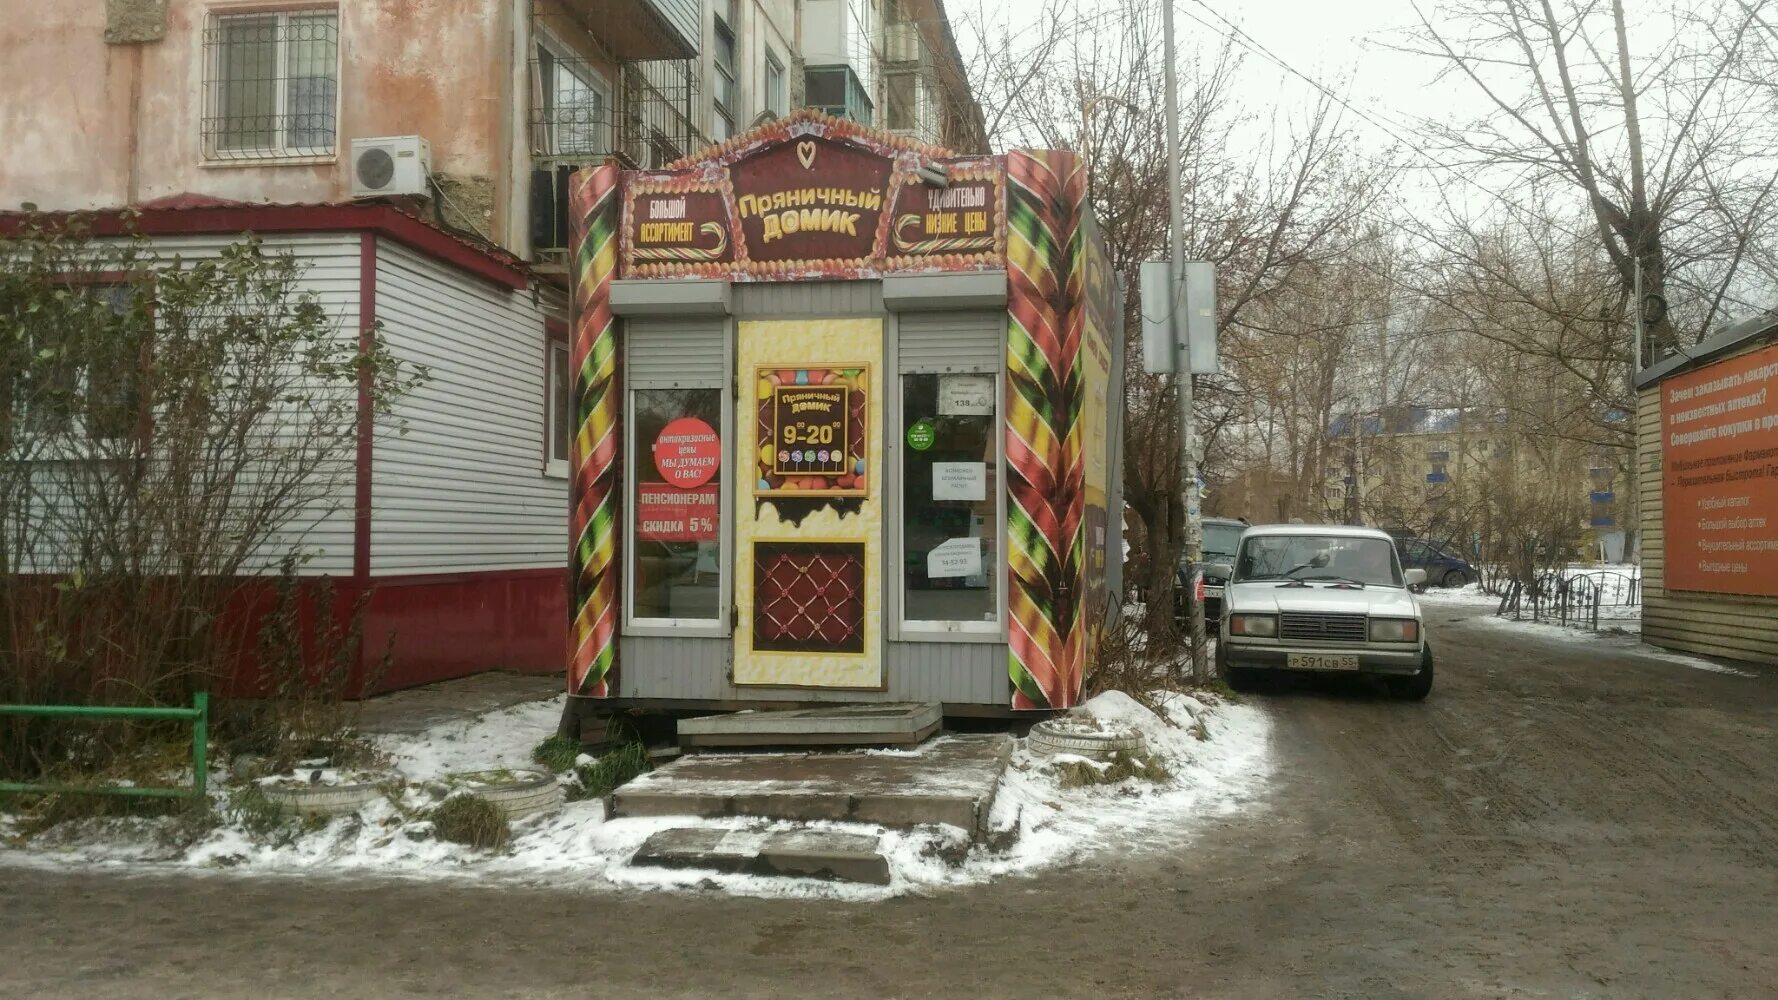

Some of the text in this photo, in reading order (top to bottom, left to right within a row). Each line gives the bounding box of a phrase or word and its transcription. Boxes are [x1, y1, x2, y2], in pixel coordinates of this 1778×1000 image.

[649, 196, 686, 219] БОЛЬШОЙ
[739, 187, 881, 219] Пряничный
[928, 186, 985, 212] УДИВИТЕЛЬНО
[640, 222, 694, 242] АССОРТИМЕНТ
[763, 208, 861, 244] ДОМИК
[926, 212, 987, 235] НИЗКИЕ ЦЕНЫ
[782, 392, 840, 404] Пряничный
[1670, 387, 1694, 404] Зачем
[1695, 374, 1742, 397] заказывать
[791, 401, 832, 414] ДОМИК
[1670, 387, 1767, 425] в неизвестных аптеках?
[1670, 425, 1718, 447] Совершайте
[1718, 419, 1753, 437] покупки
[1754, 418, 1761, 430] в
[678, 446, 697, 456] цены
[661, 457, 715, 469] МЫ ДУМАЕМ
[675, 470, 702, 479] О ВАС!
[641, 493, 716, 505] ПЕНСИОНЕРАМ
[643, 520, 684, 533] СКИДКА
